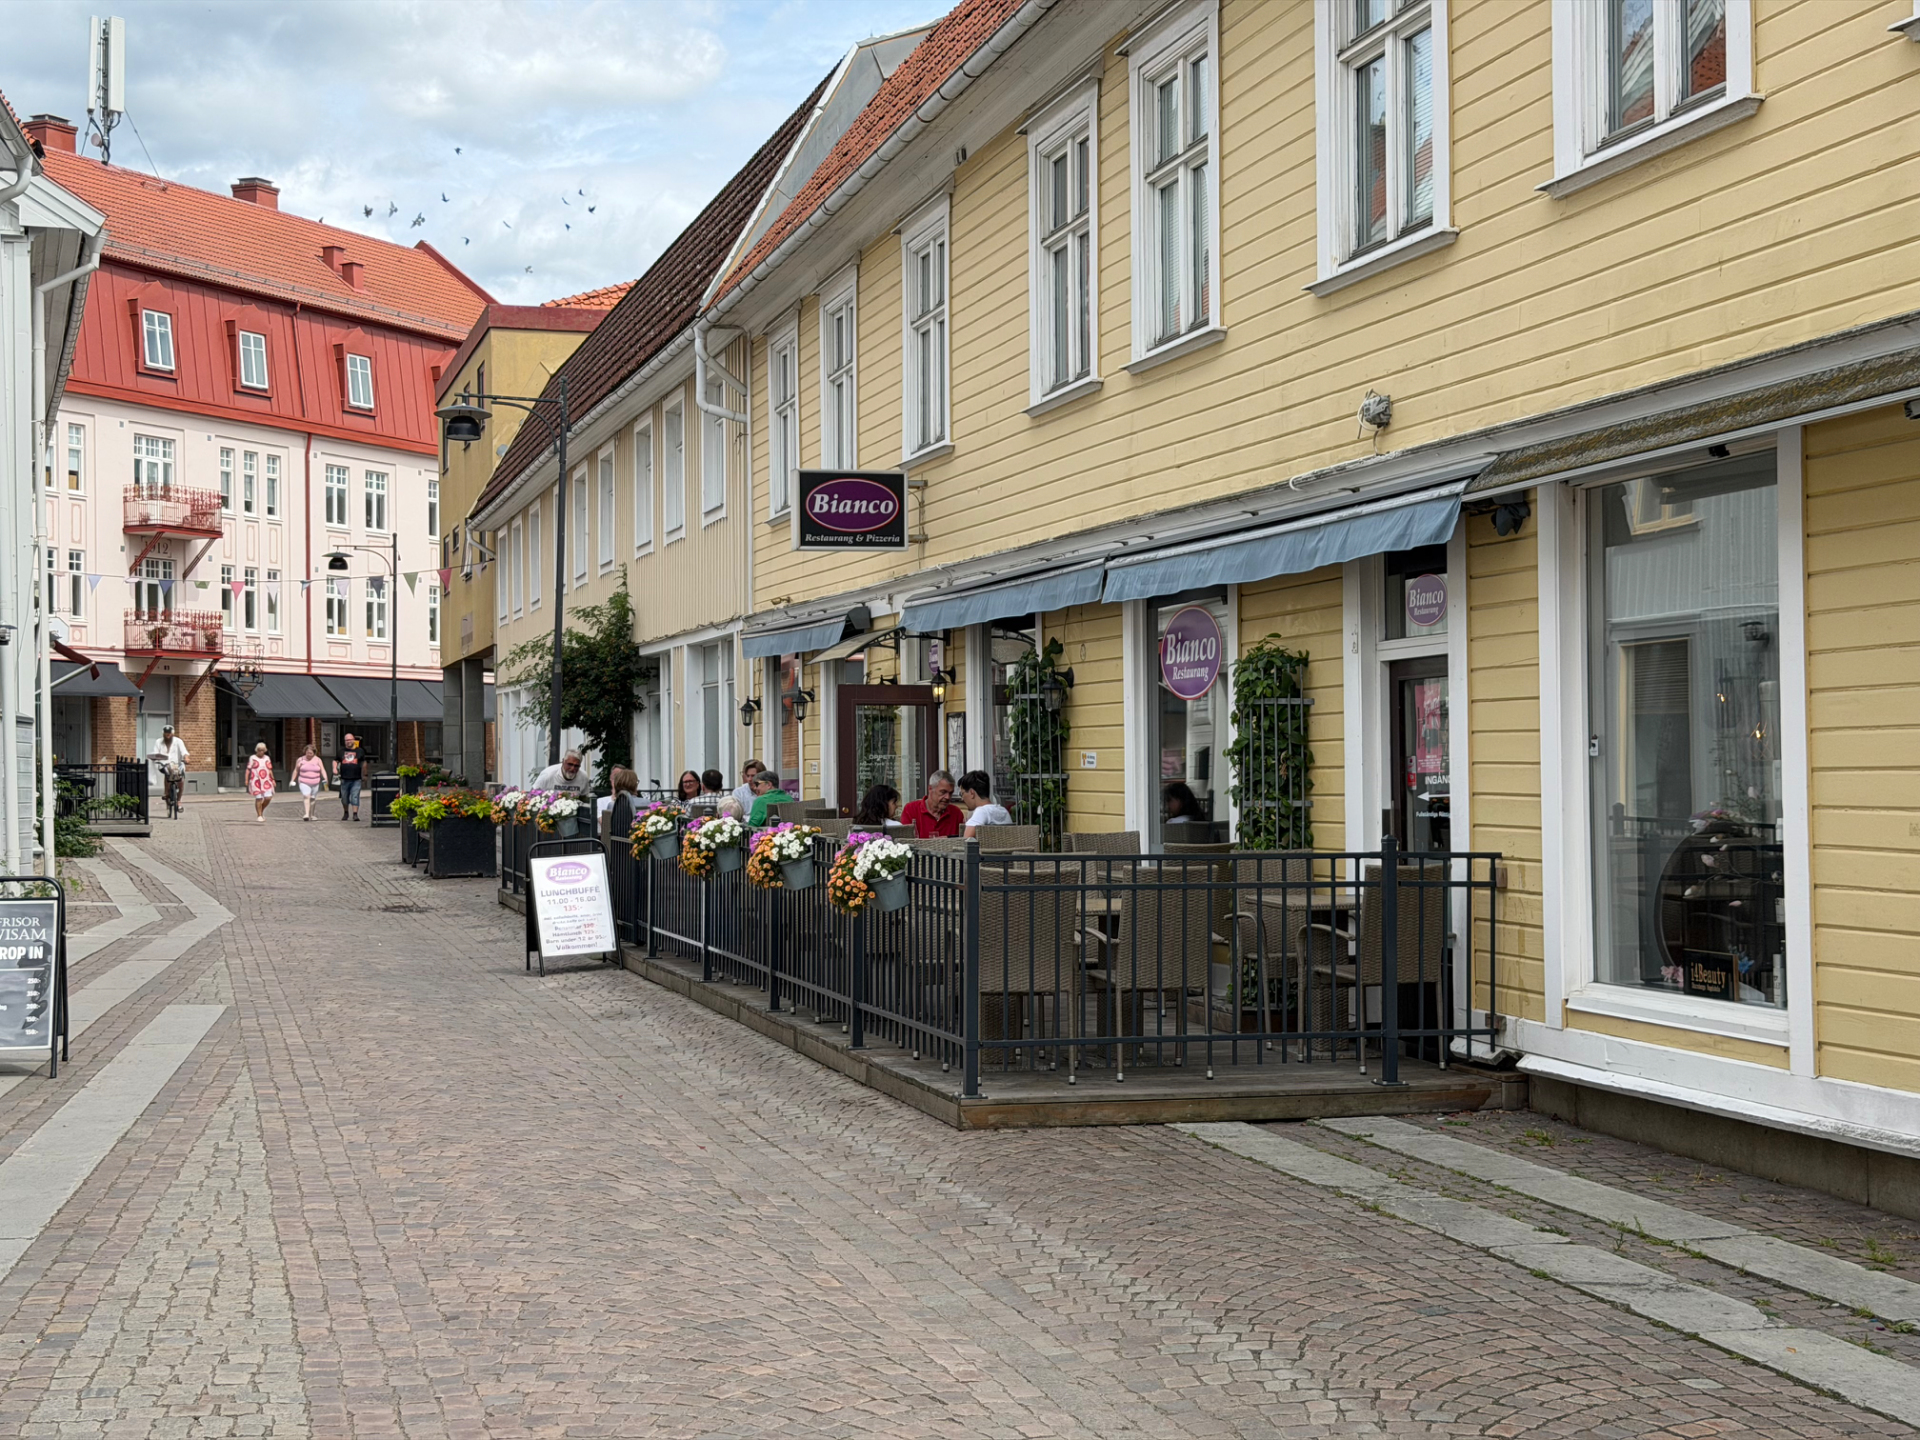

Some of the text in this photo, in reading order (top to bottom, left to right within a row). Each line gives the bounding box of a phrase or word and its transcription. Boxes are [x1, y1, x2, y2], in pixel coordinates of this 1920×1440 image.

[812, 493, 894, 515] Bianco
[805, 533, 900, 545] Restaurang & Pizzeria
[1409, 588, 1444, 608] Bianco
[1165, 631, 1216, 665] Bianco
[1172, 666, 1209, 682] Restaurang
[549, 867, 588, 877] Bianco
[547, 898, 569, 906] 11.00
[28, 946, 44, 960] IN
[1690, 961, 1726, 989] i4Beauty
